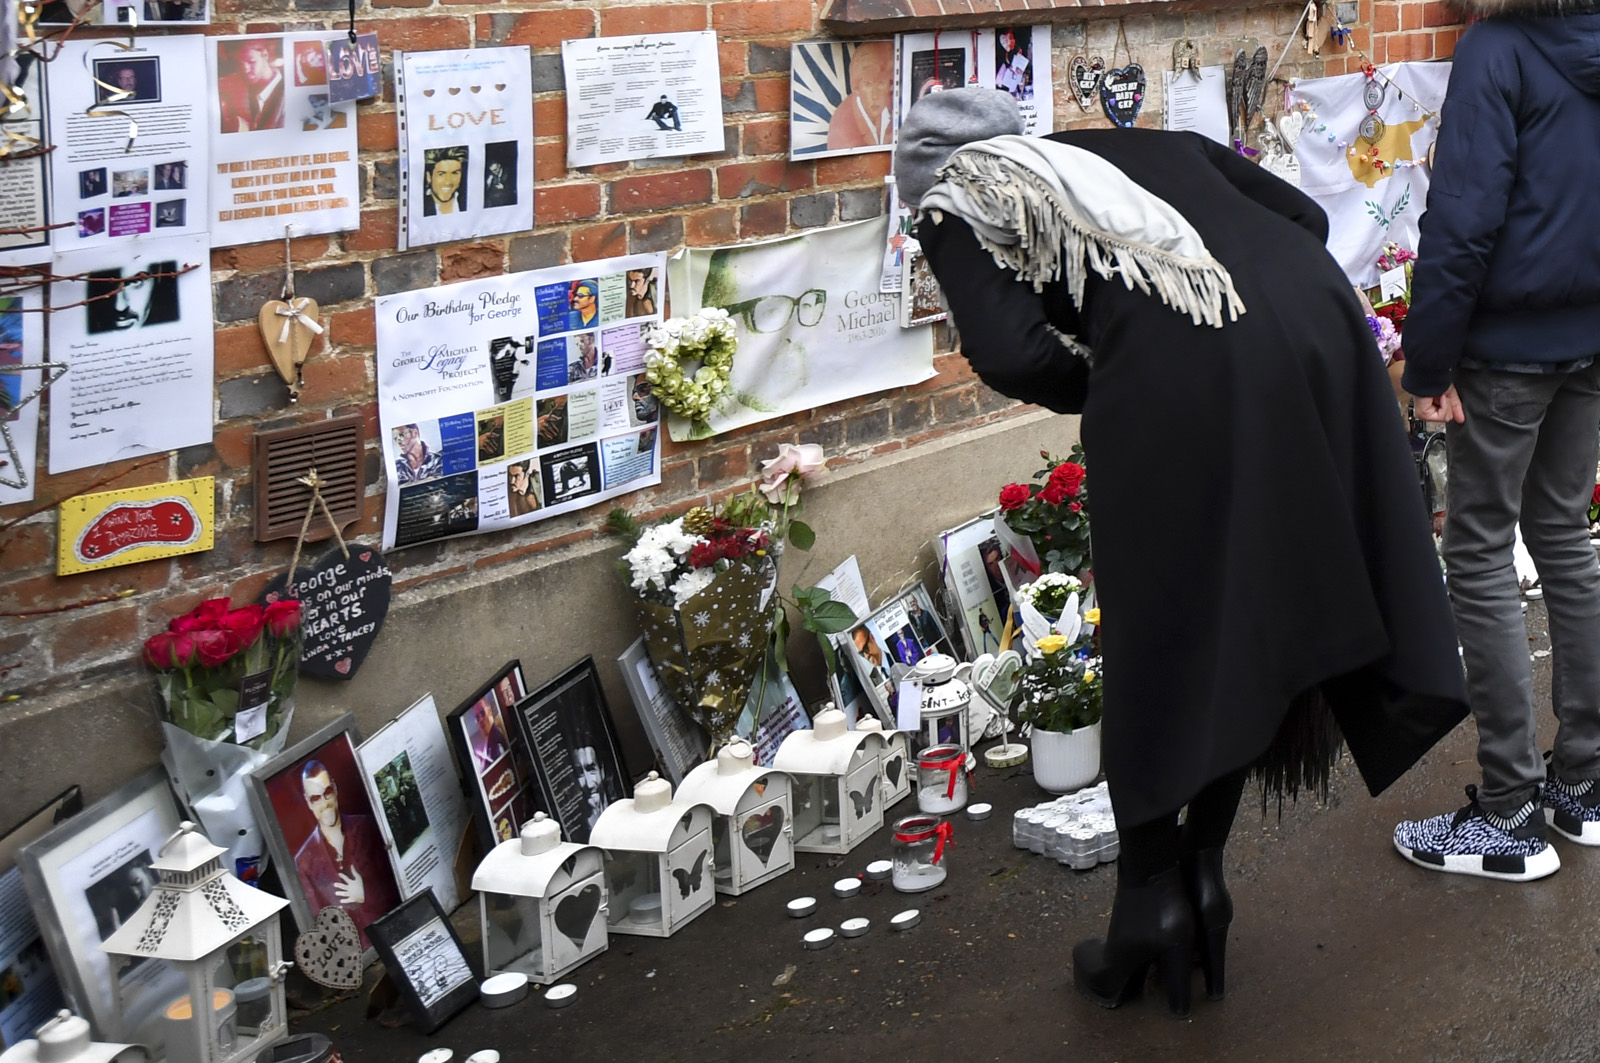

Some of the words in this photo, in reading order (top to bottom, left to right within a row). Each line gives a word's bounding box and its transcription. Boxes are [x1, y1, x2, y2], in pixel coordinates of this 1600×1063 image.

[328, 42, 379, 81] LOVE
[1115, 91, 1134, 101] BABY
[427, 108, 507, 132] LOVE
[396, 306, 419, 324] Our
[422, 299, 474, 319] Birthday
[478, 291, 521, 310] Pledge
[844, 290, 900, 309] George
[468, 312, 485, 326] for
[487, 306, 522, 320] George
[837, 302, 896, 333] Michael
[392, 355, 425, 368] GEORGE
[438, 345, 479, 358] MICHAEL
[391, 395, 398, 403] A
[398, 388, 438, 401] NONPROFIT
[438, 380, 484, 394] FOUNDATION
[92, 525, 102, 539] I
[133, 509, 157, 523] YOUR
[288, 563, 347, 599] George
[316, 590, 332, 602] on
[334, 580, 354, 595] our
[325, 600, 338, 611] in
[340, 586, 367, 606] our
[338, 621, 376, 643] TRACEY
[316, 931, 347, 969] LOVE
